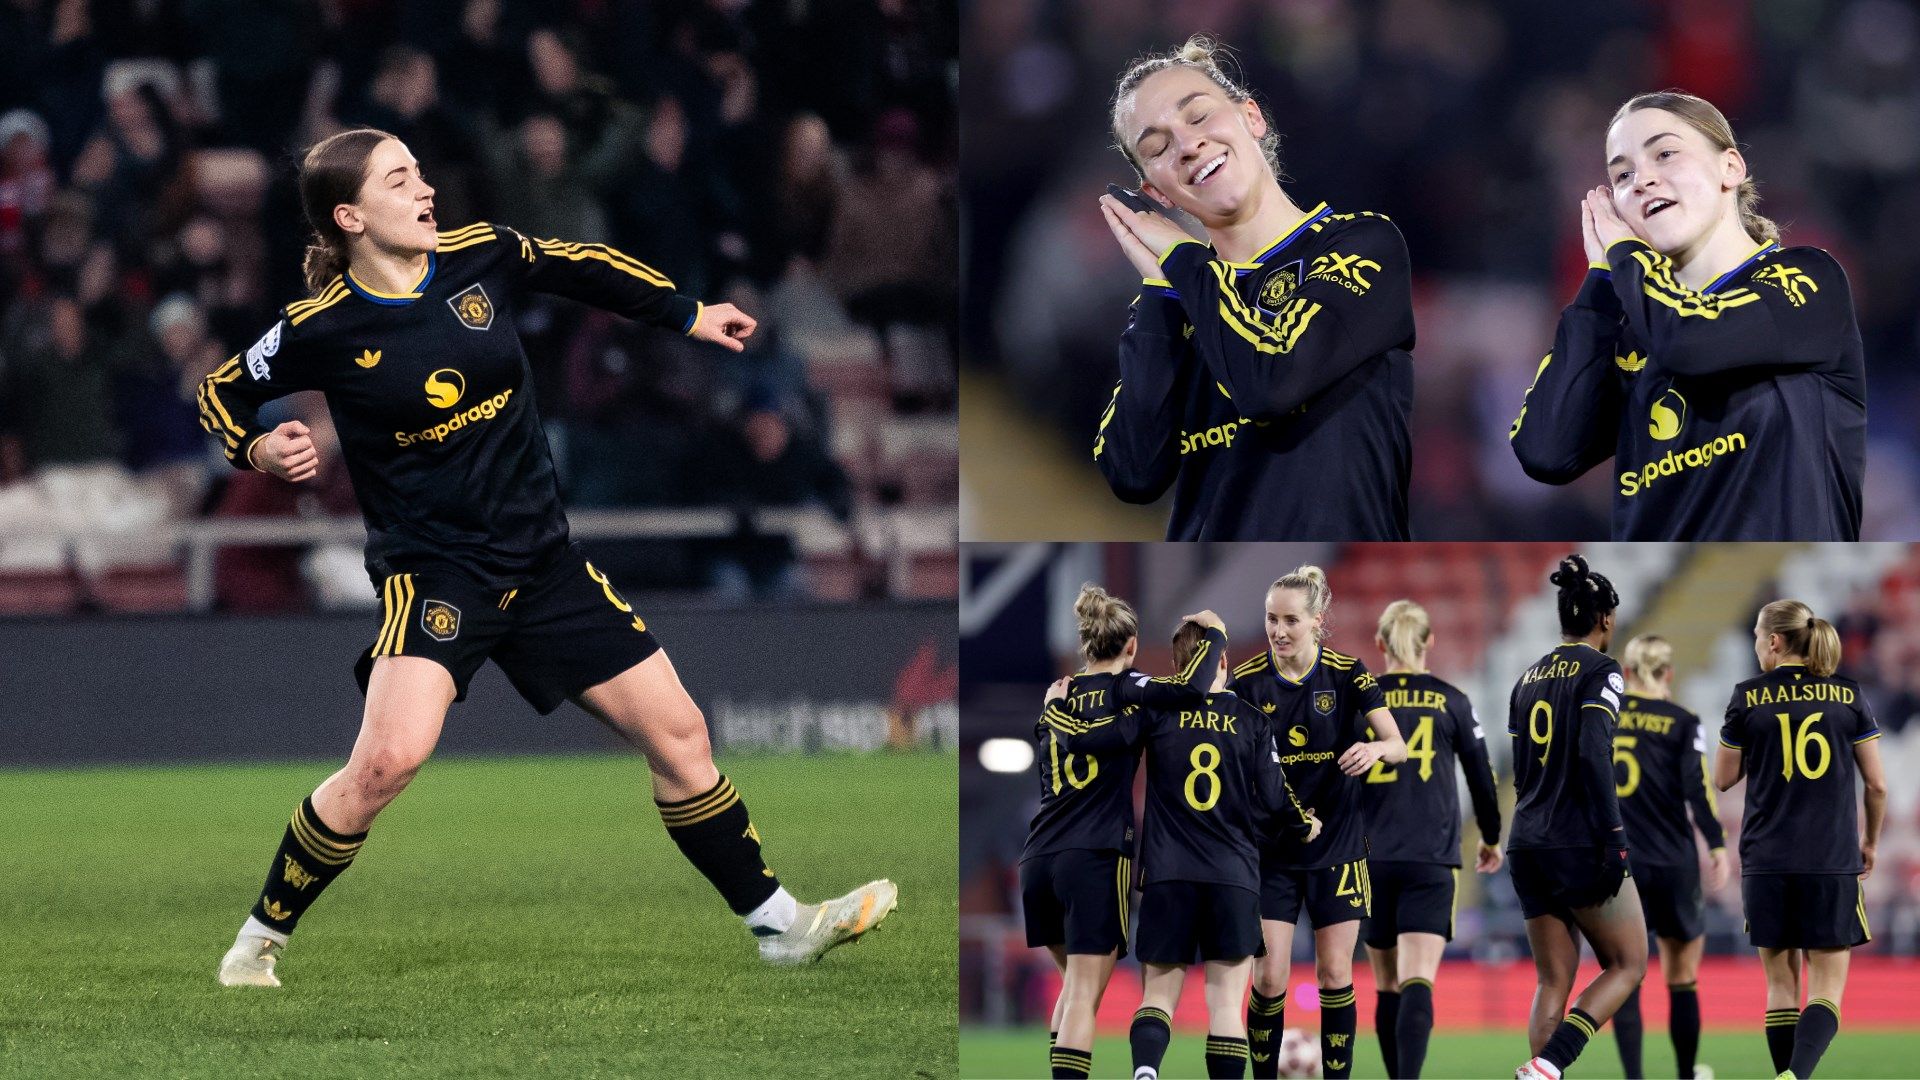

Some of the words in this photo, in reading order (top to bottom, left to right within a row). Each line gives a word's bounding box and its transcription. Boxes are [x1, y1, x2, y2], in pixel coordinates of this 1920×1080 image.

[1305, 274, 1366, 297] NOLOGY
[1620, 432, 1746, 496] Spdragon
[1067, 690, 1106, 714] OTTI
[1745, 684, 1855, 708] NAALSUND
[1179, 711, 1238, 735] PARK
[1529, 699, 1553, 768] 9
[1775, 712, 1831, 784] 16
[1184, 742, 1222, 812] 8
